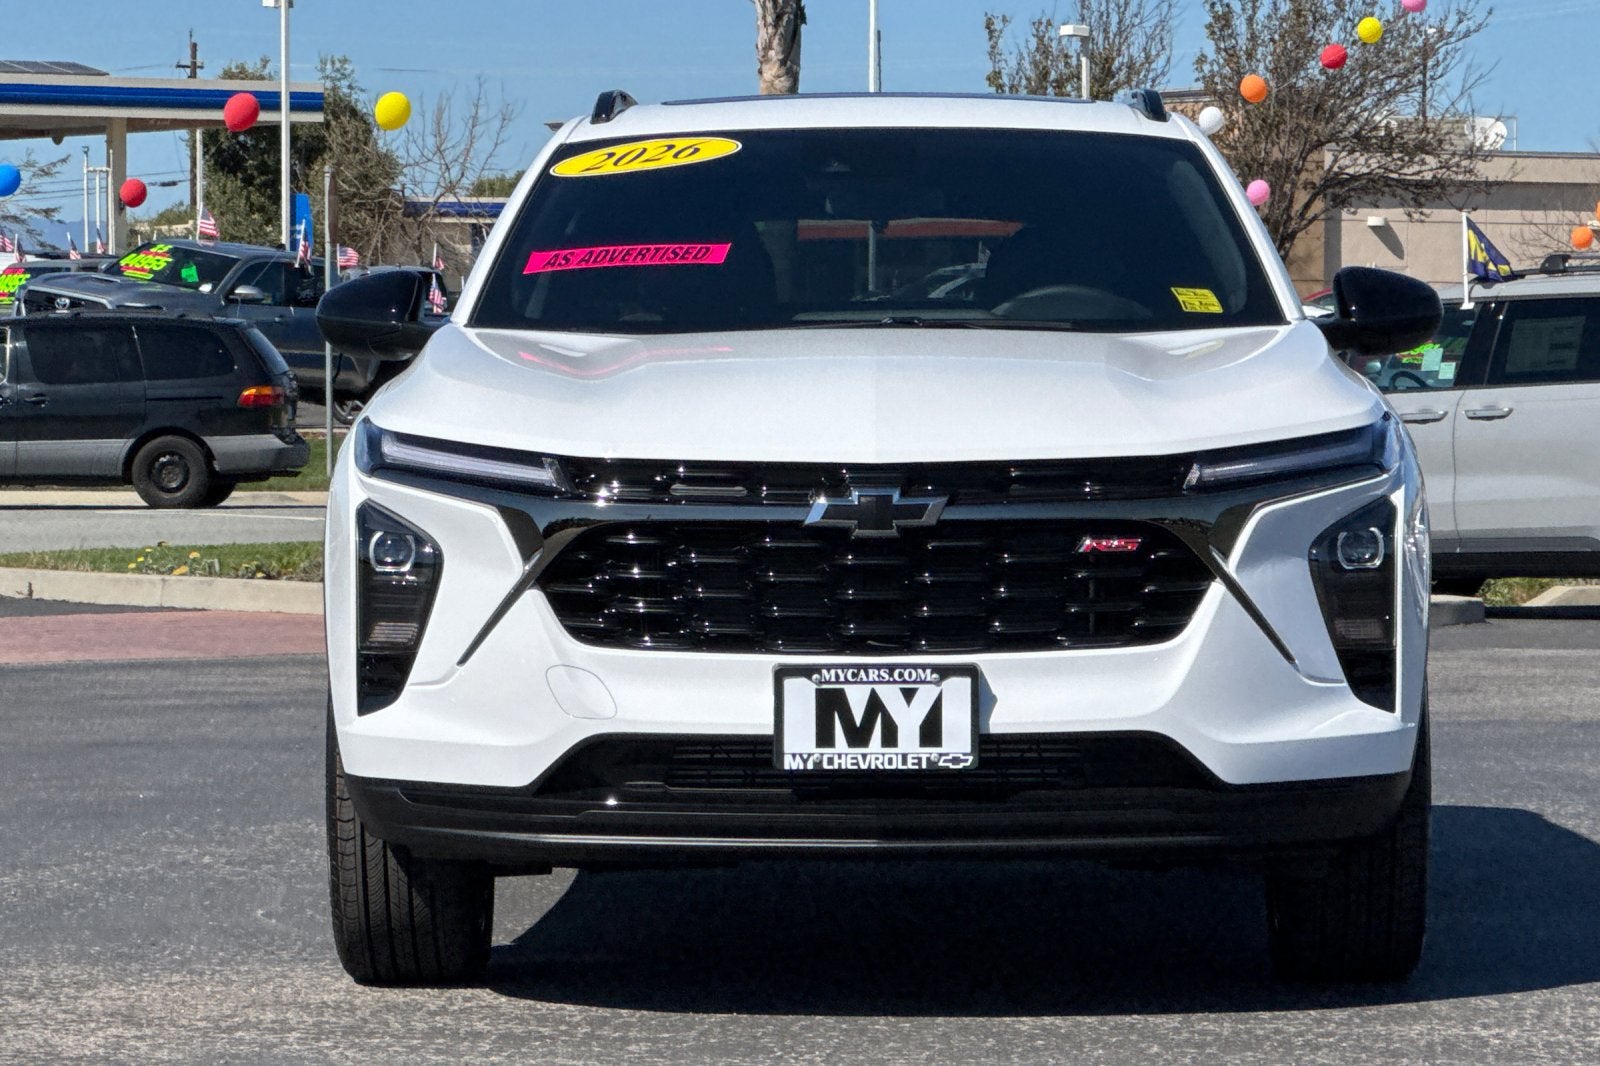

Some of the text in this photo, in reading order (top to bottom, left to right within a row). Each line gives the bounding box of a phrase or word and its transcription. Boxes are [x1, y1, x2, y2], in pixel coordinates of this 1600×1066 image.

[578, 141, 711, 173] 2026
[543, 245, 711, 269] AS ADVERTISED
[821, 669, 933, 682] MYCARS.COM
[815, 687, 943, 748] MY
[784, 754, 928, 770] MY CHEVROLET
